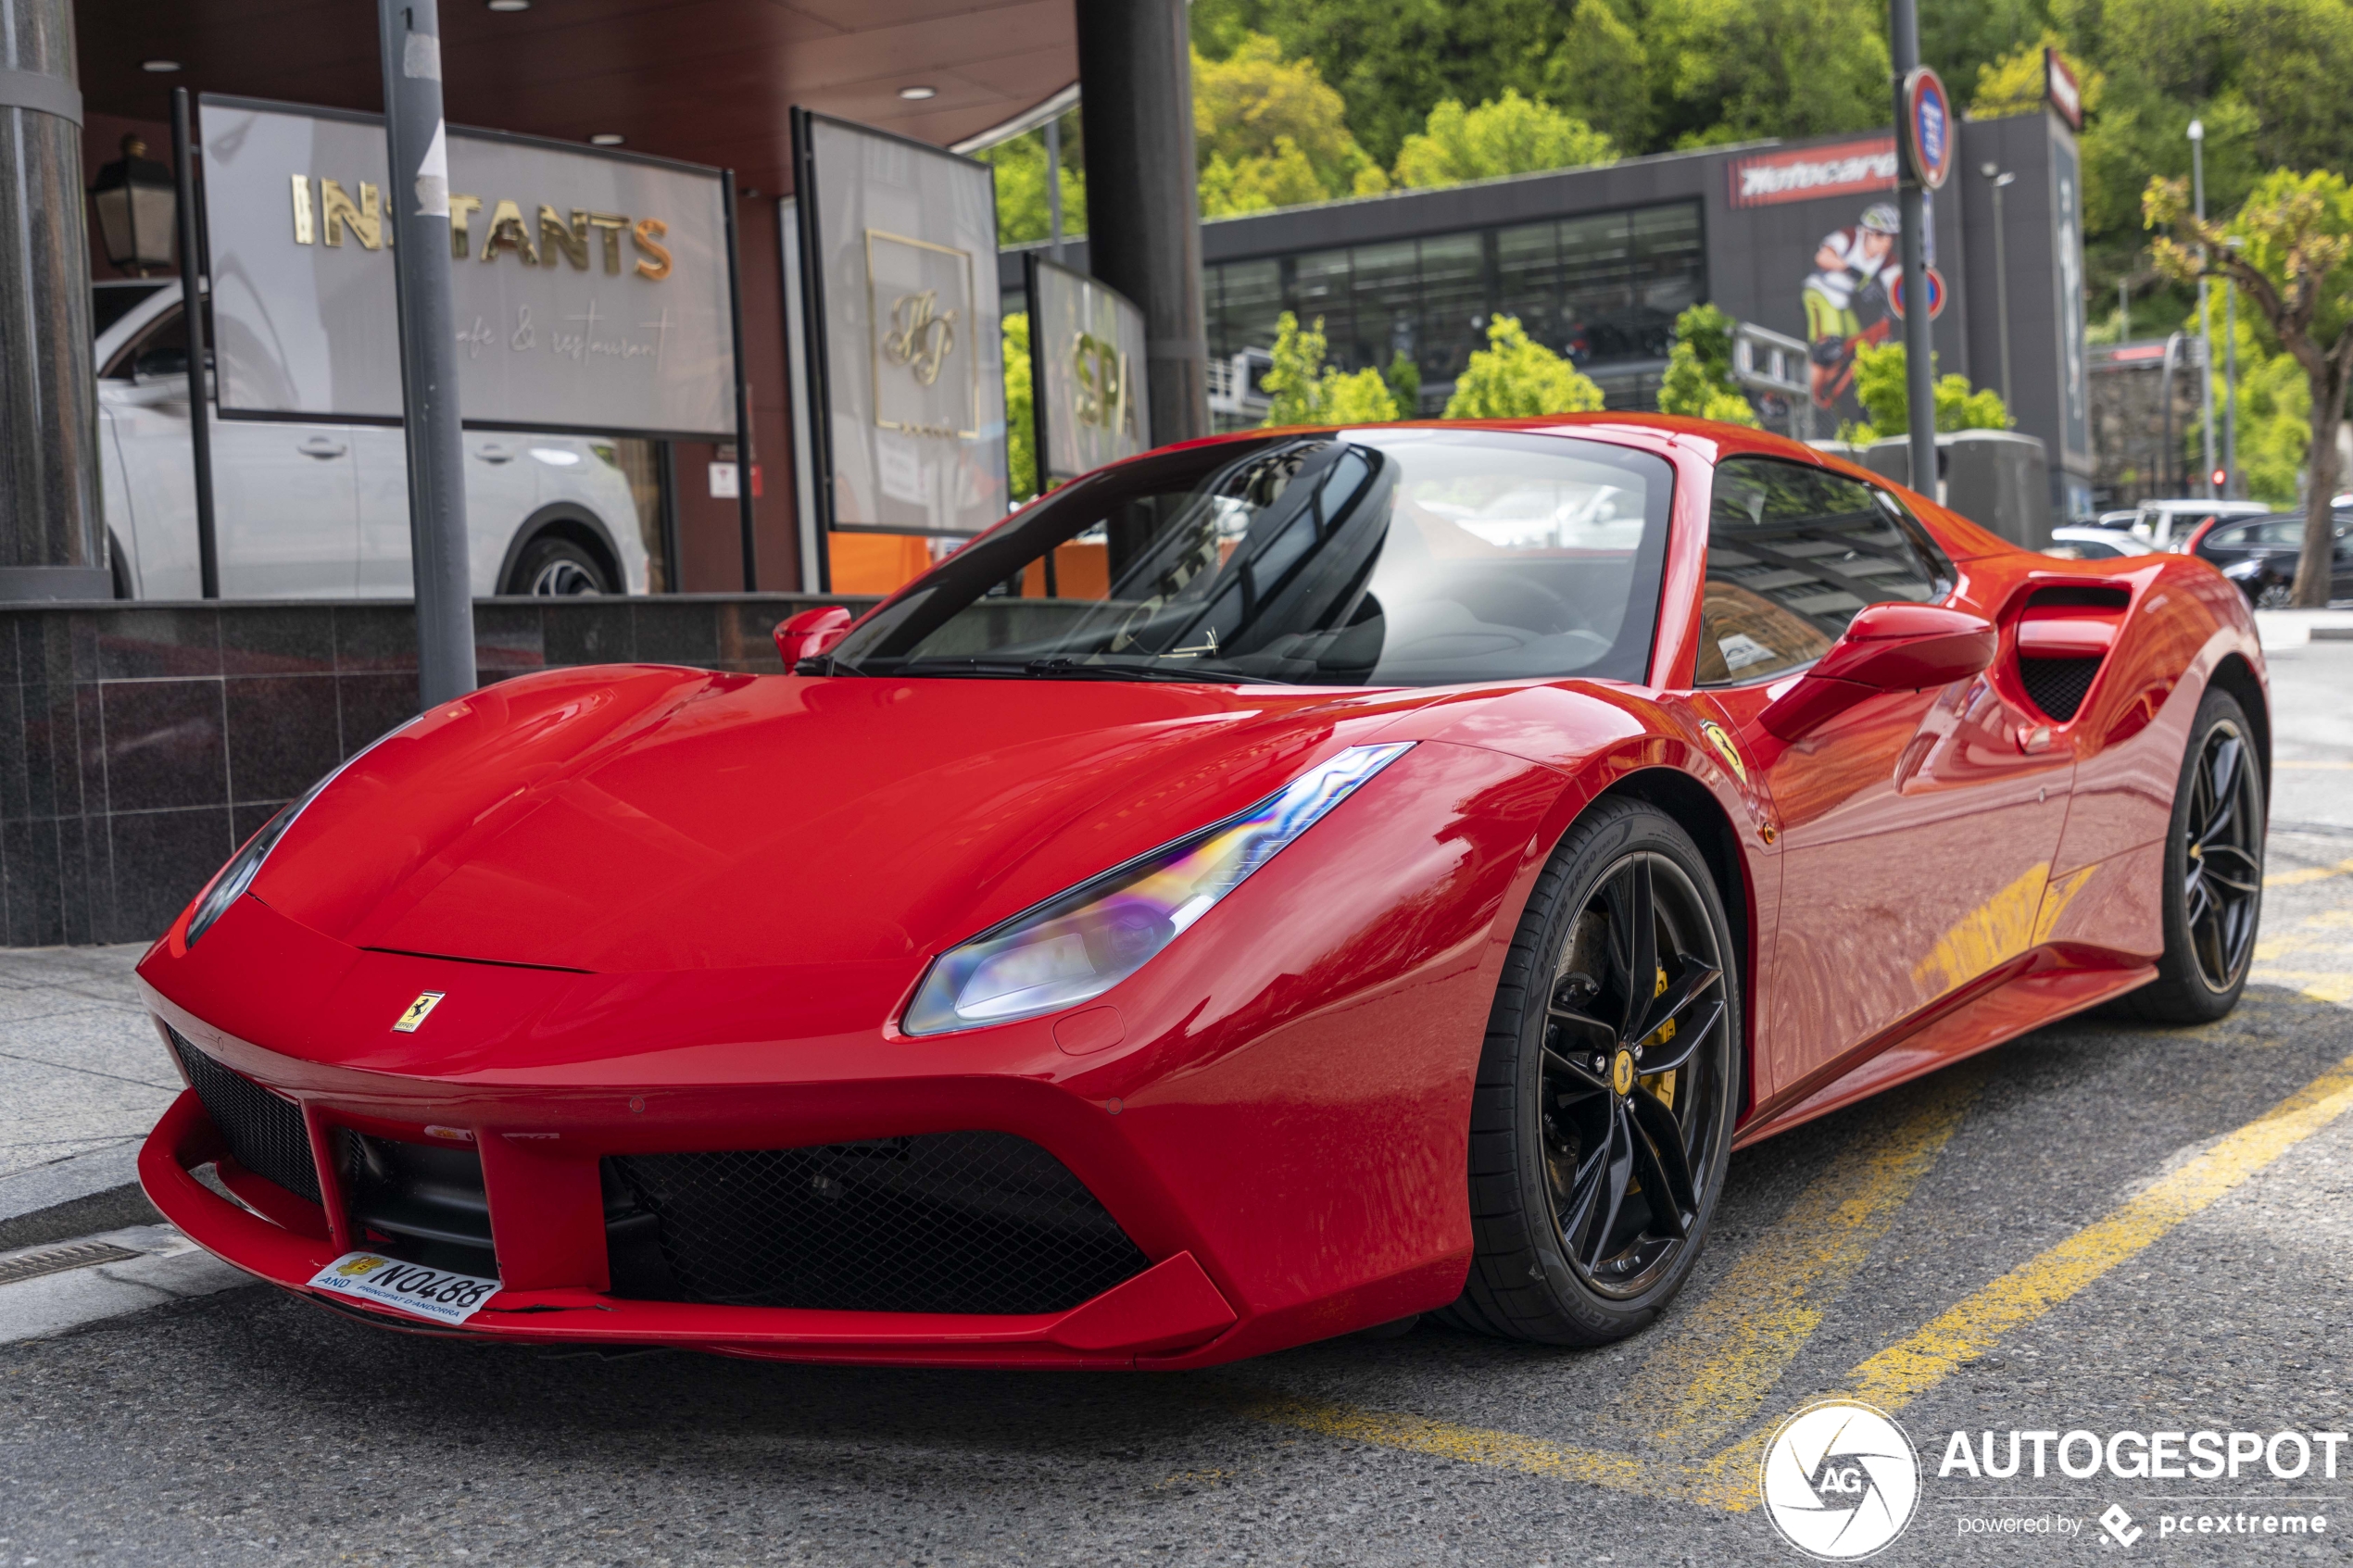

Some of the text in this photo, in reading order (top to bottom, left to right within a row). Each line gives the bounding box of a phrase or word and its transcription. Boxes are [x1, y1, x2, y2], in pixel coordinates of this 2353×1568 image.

[291, 174, 673, 282] INTANTS
[455, 299, 676, 371] afe & restaurant
[317, 1275, 352, 1289] AND
[357, 1284, 461, 1318] PRINCIPAT D'ANDORRA
[1560, 1286, 1621, 1332] ZERO
